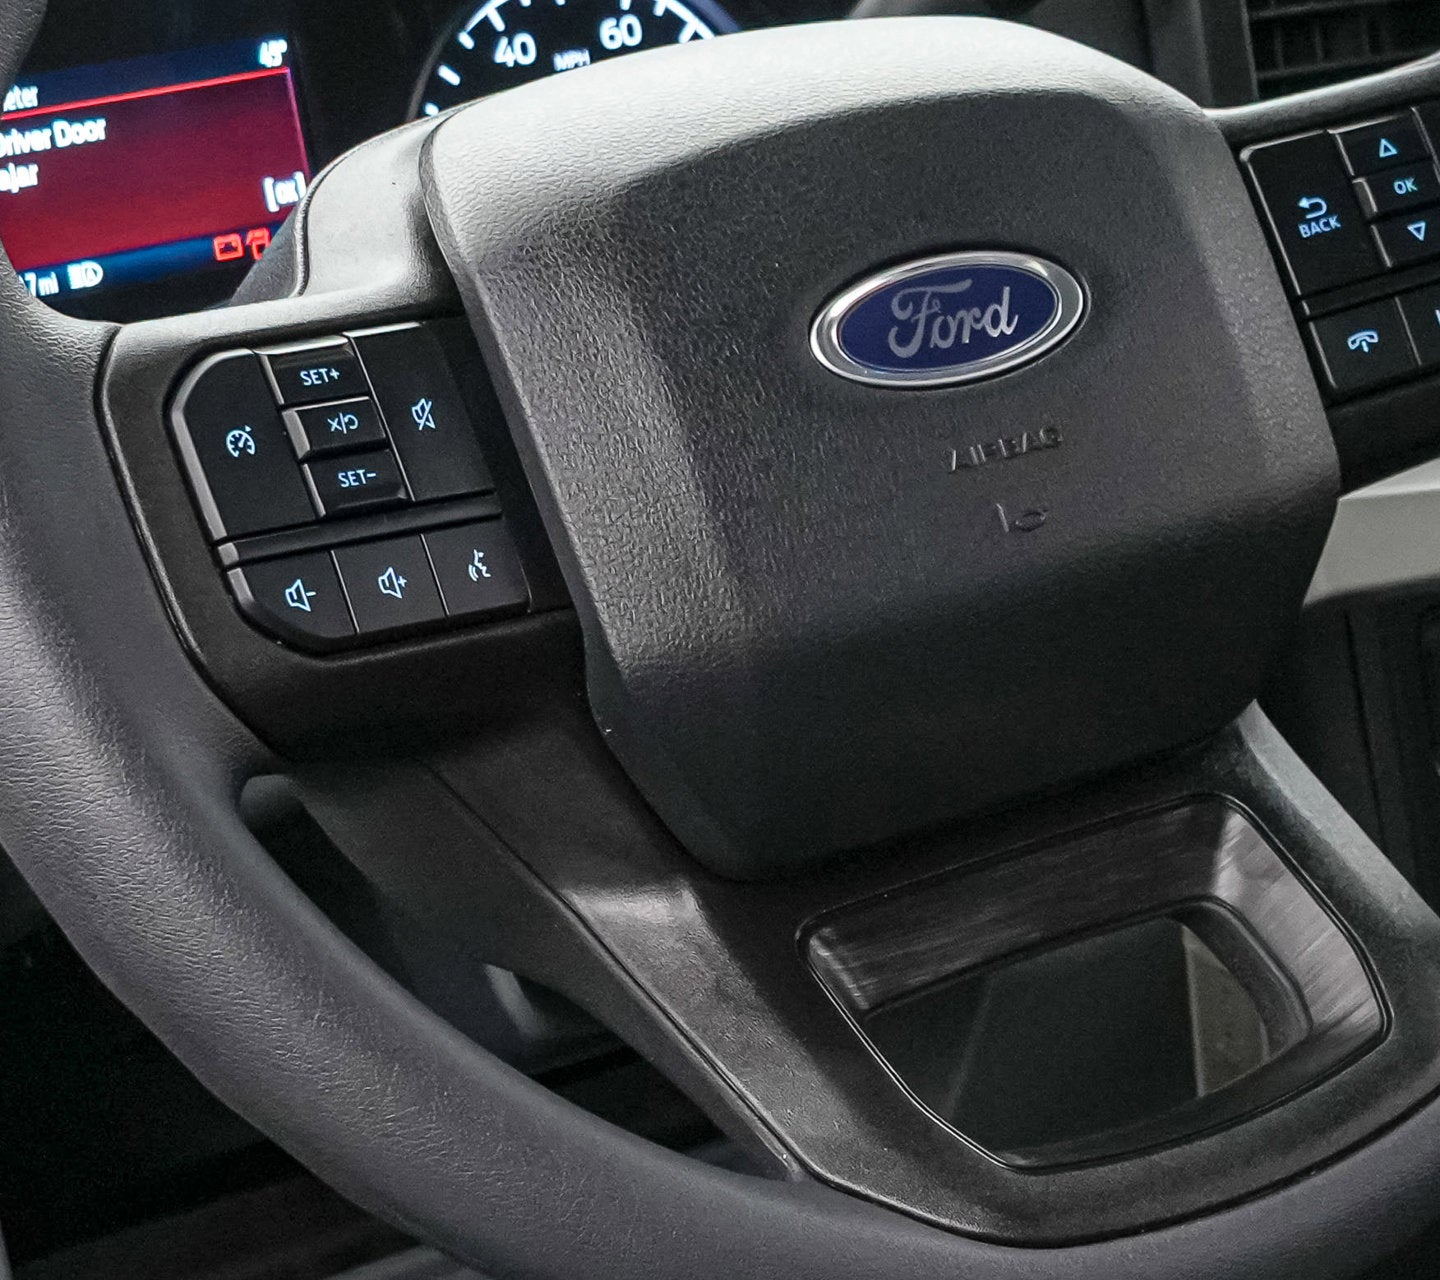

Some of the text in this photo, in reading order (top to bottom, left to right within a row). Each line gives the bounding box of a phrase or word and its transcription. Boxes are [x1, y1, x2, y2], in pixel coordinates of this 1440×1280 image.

[599, 14, 643, 50] 60
[493, 32, 537, 67] 40
[553, 48, 591, 70] MPH
[52, 118, 107, 148] Door
[1393, 177, 1419, 195] OK
[1297, 214, 1342, 239] BACK
[888, 278, 1018, 358] Ford
[300, 367, 340, 387] SET+
[337, 468, 377, 488] SET-
